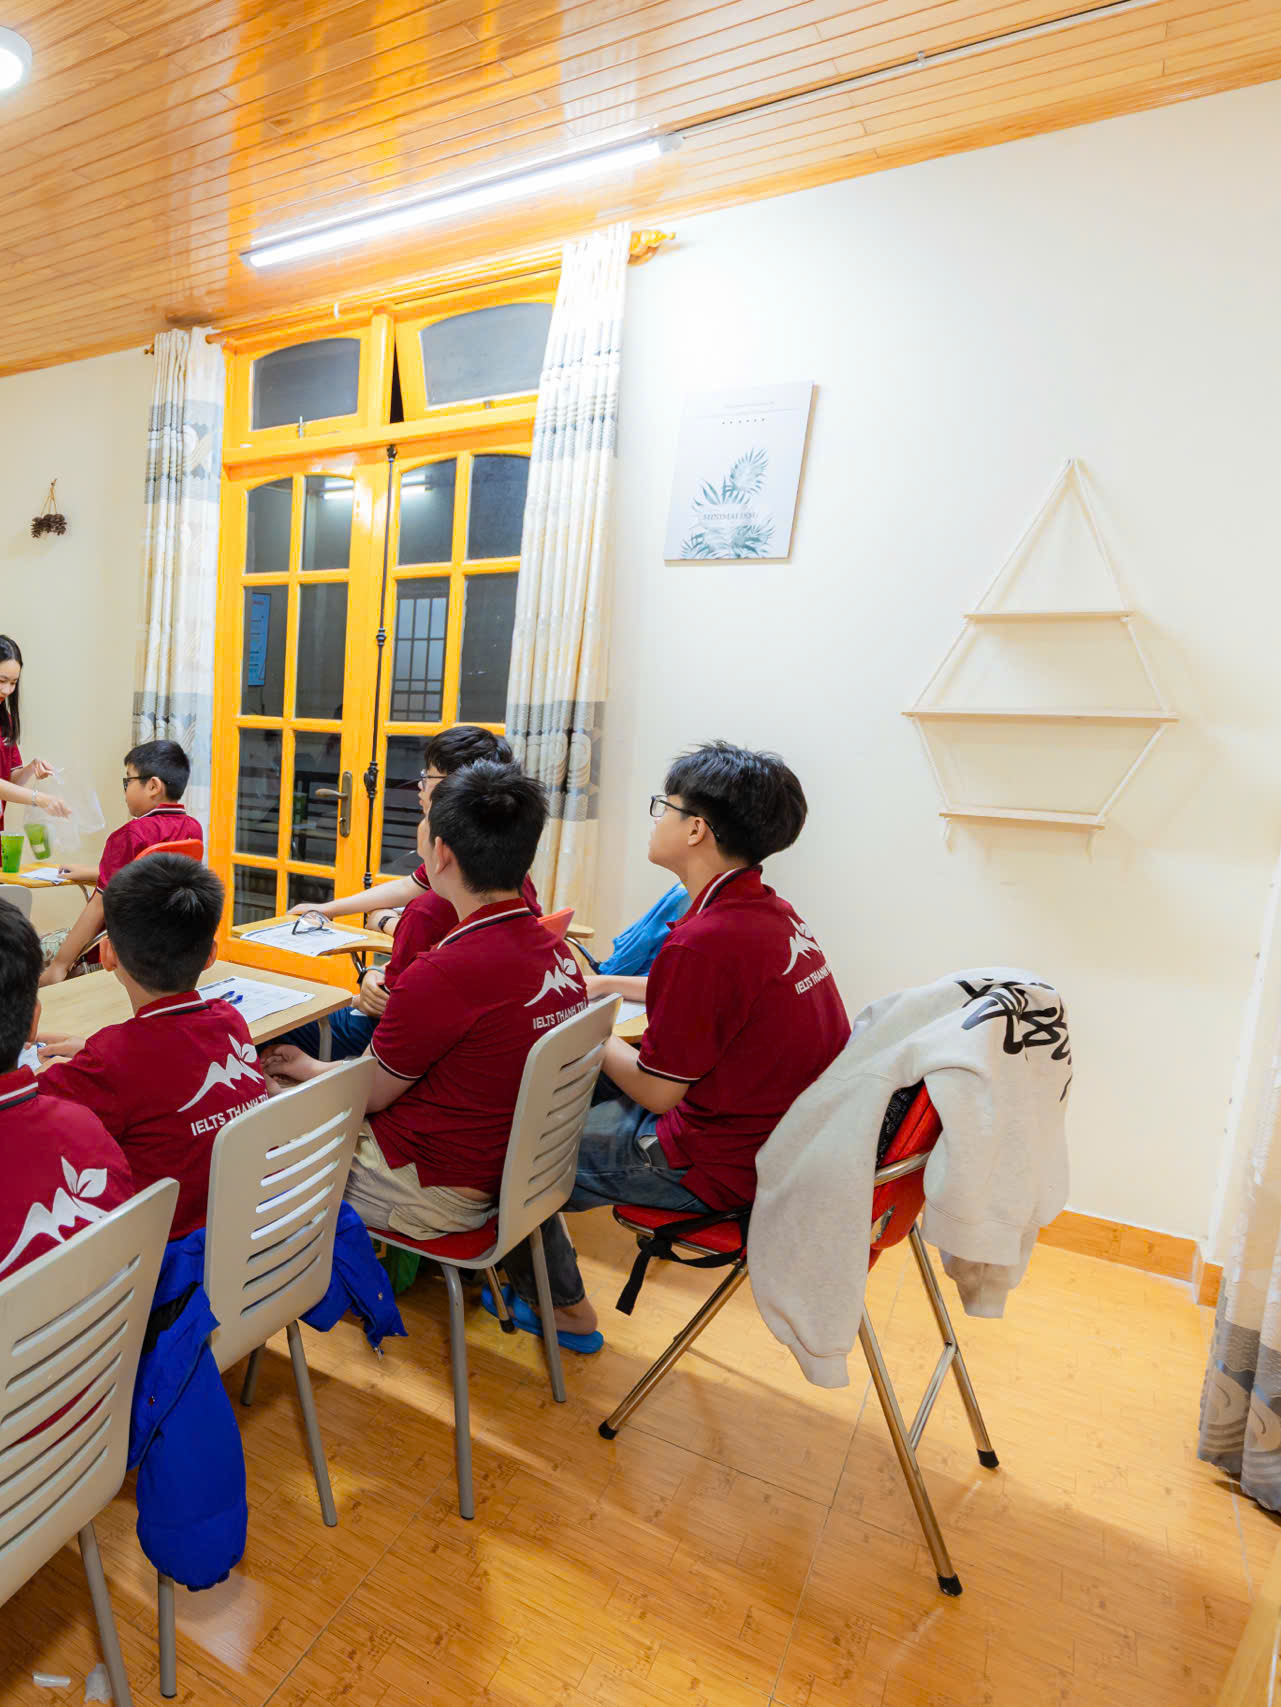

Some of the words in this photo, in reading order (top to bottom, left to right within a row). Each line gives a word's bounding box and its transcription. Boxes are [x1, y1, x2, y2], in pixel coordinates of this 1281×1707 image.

[794, 976, 813, 995] IELTS
[532, 1013, 556, 1030] IELTS
[190, 1112, 226, 1136] IELTS
